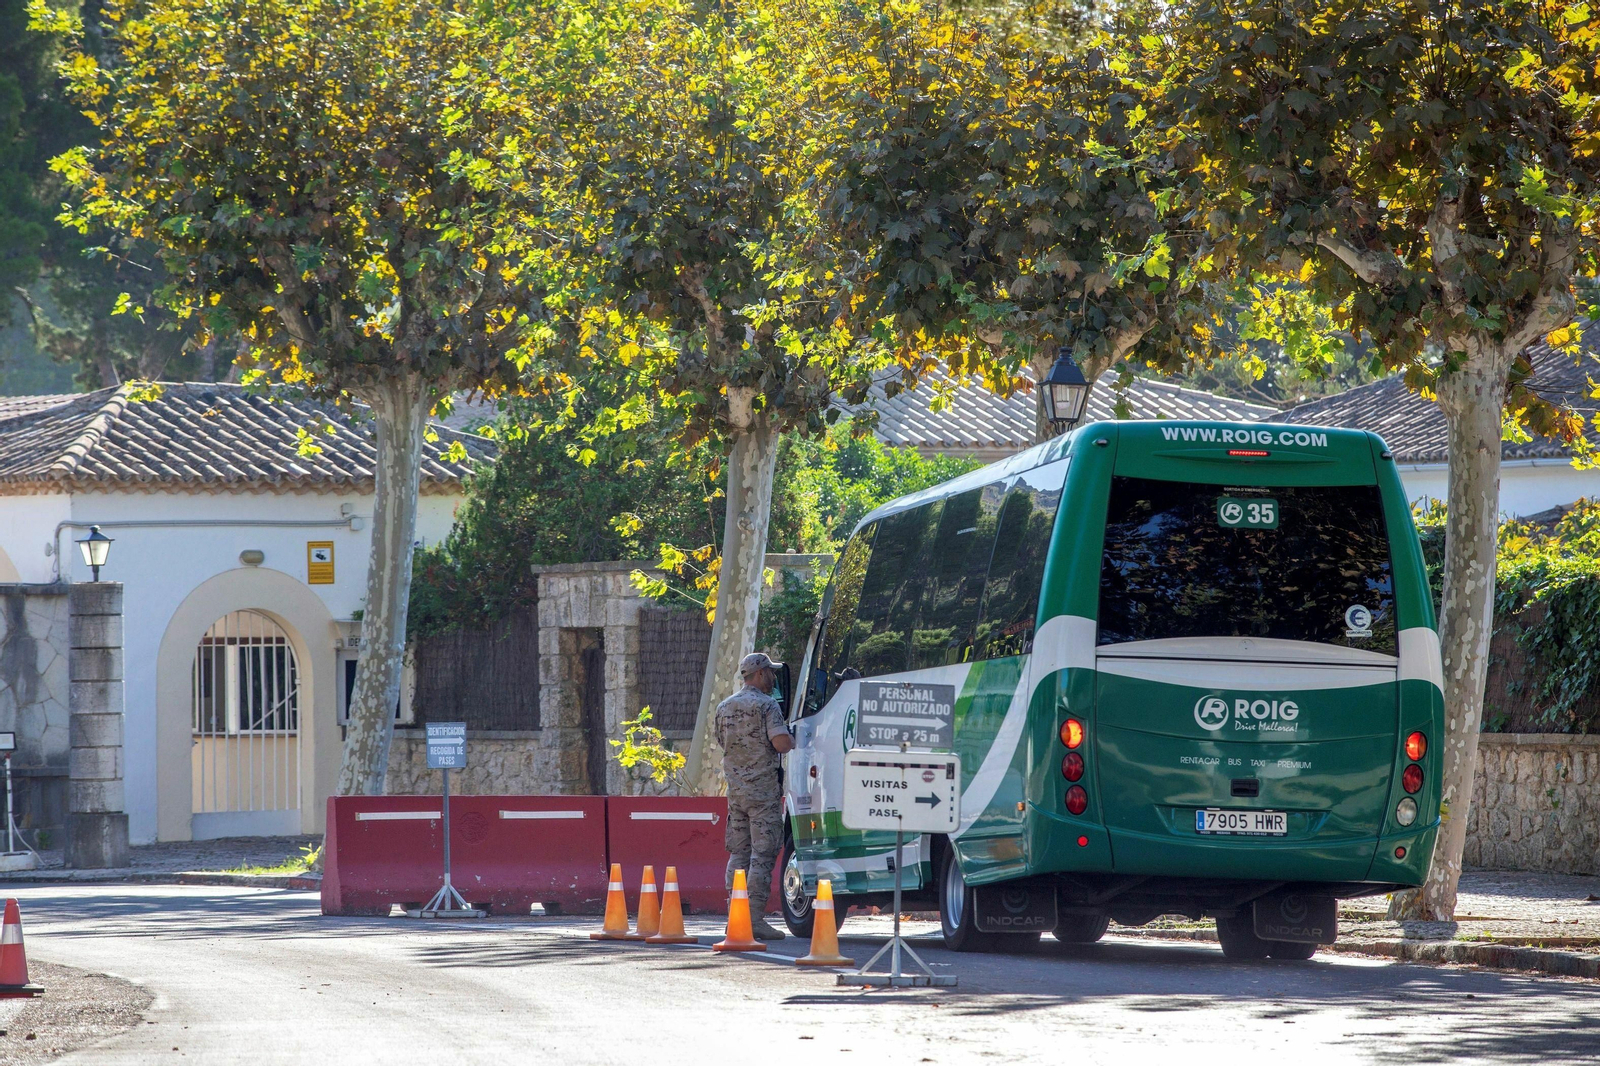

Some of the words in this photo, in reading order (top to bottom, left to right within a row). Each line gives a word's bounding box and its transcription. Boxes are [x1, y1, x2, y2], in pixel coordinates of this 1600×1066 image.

[1161, 427, 1328, 447] WWW.ROIG.COM
[1247, 503, 1275, 524] 35
[879, 687, 935, 701] PERSONAL
[862, 699, 878, 712] NO
[882, 701, 950, 716] AUTORIZADO
[1234, 699, 1299, 721] ROIG
[1234, 720, 1256, 731] Drive
[1258, 720, 1298, 732] Mallorca!
[869, 727, 898, 740] STOP
[930, 733, 940, 743] m
[430, 746, 455, 755] RECOGIDA
[456, 746, 464, 755] DE
[438, 756, 455, 765] PASES
[1228, 758, 1241, 766] BUS
[1250, 759, 1266, 767] TAXI
[1277, 760, 1312, 769] PREMIUM
[862, 779, 908, 789] VISITAS
[874, 794, 894, 803] SIN
[868, 808, 899, 818] PASE
[1207, 813, 1248, 829] 7905
[1255, 814, 1283, 830] HWR
[986, 916, 1046, 926] INDCAR
[1265, 924, 1323, 938] INDCAR
